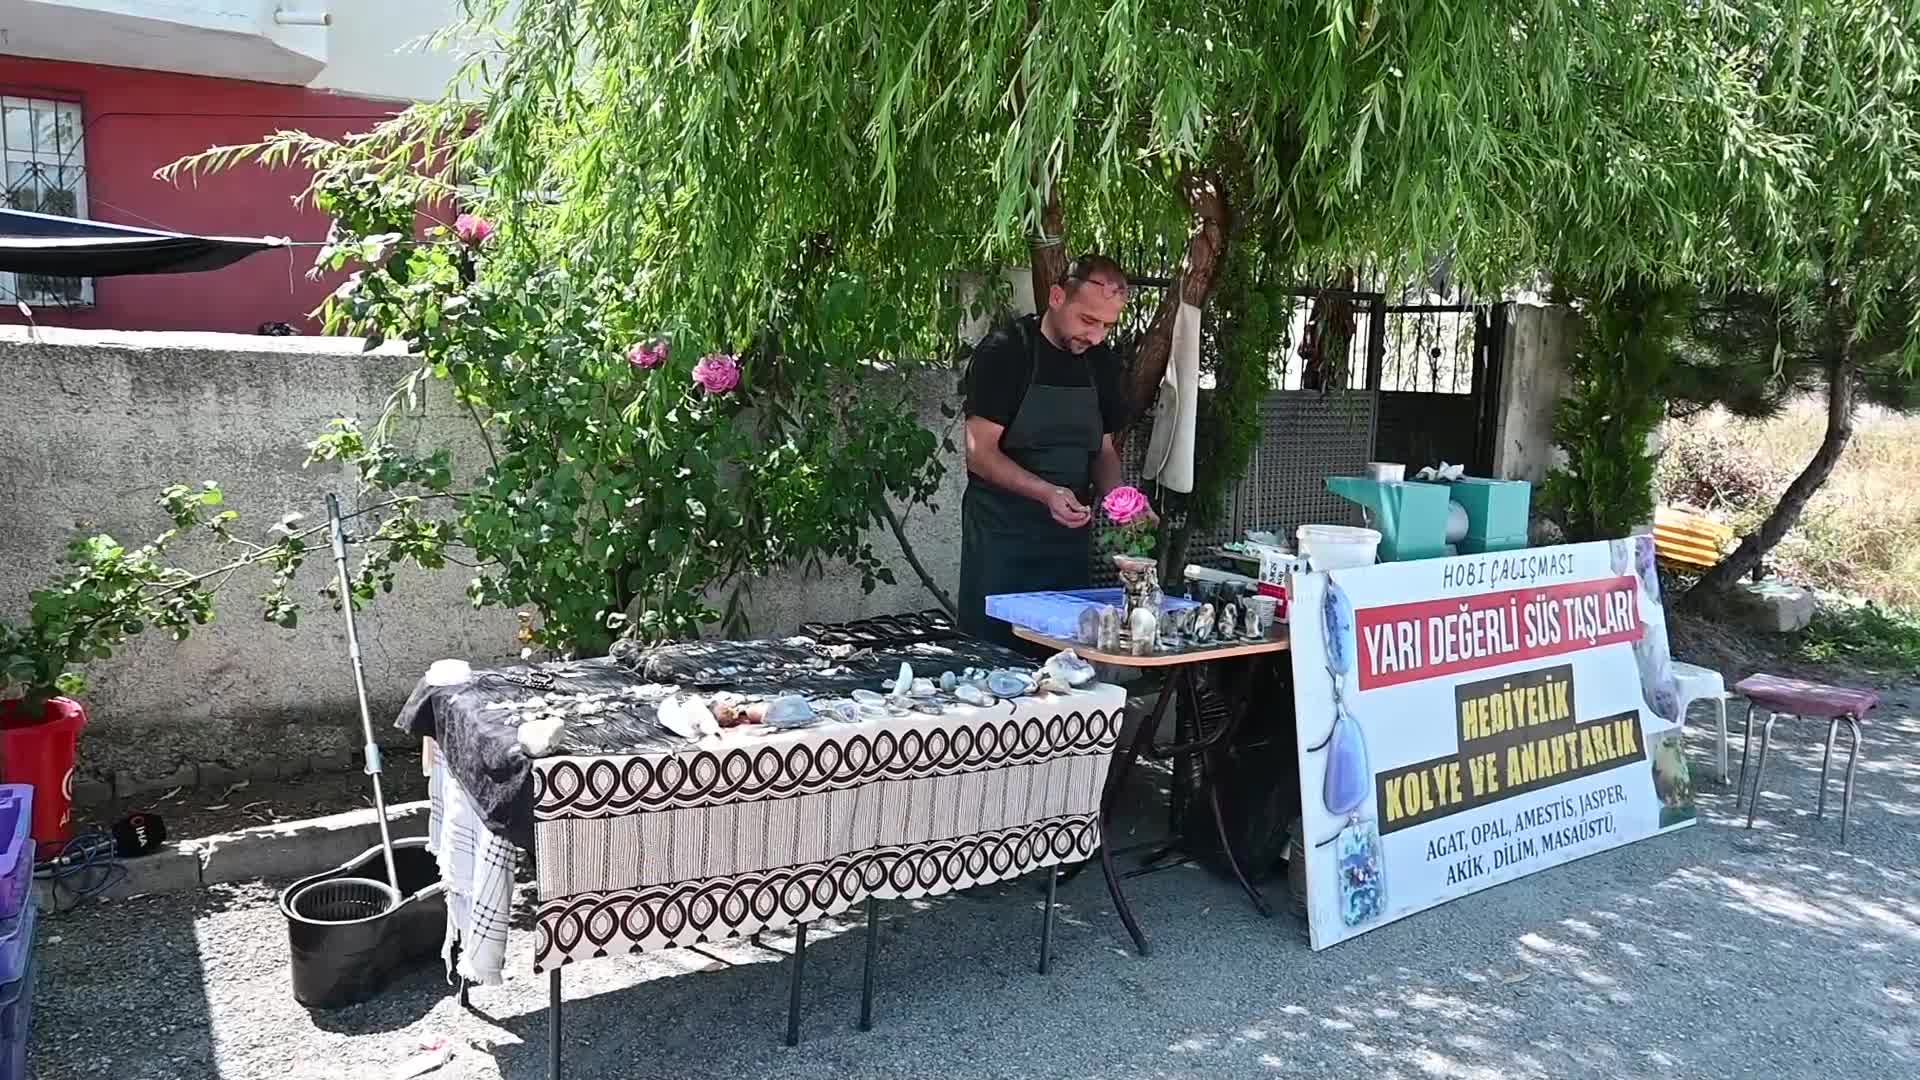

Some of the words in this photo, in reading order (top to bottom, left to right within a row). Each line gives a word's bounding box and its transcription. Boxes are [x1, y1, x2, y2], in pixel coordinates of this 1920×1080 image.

[1443, 557, 1486, 588] HOBİ
[1490, 553, 1575, 588] ÇALIŞMASI
[1363, 618, 1423, 676] YARI
[1428, 598, 1519, 666] DEĞERLİ
[1524, 594, 1561, 649] SÜS
[1563, 589, 1636, 645] TAŞLARI
[1461, 675, 1570, 741] HEDİYELİK
[1385, 761, 1463, 822] KOLYE
[1469, 751, 1500, 797] VE
[1507, 718, 1638, 787] ANAHTARLIK
[1426, 830, 1469, 861] AGAT,
[1471, 818, 1513, 846] OPAL,
[1579, 784, 1628, 817] JASPER,
